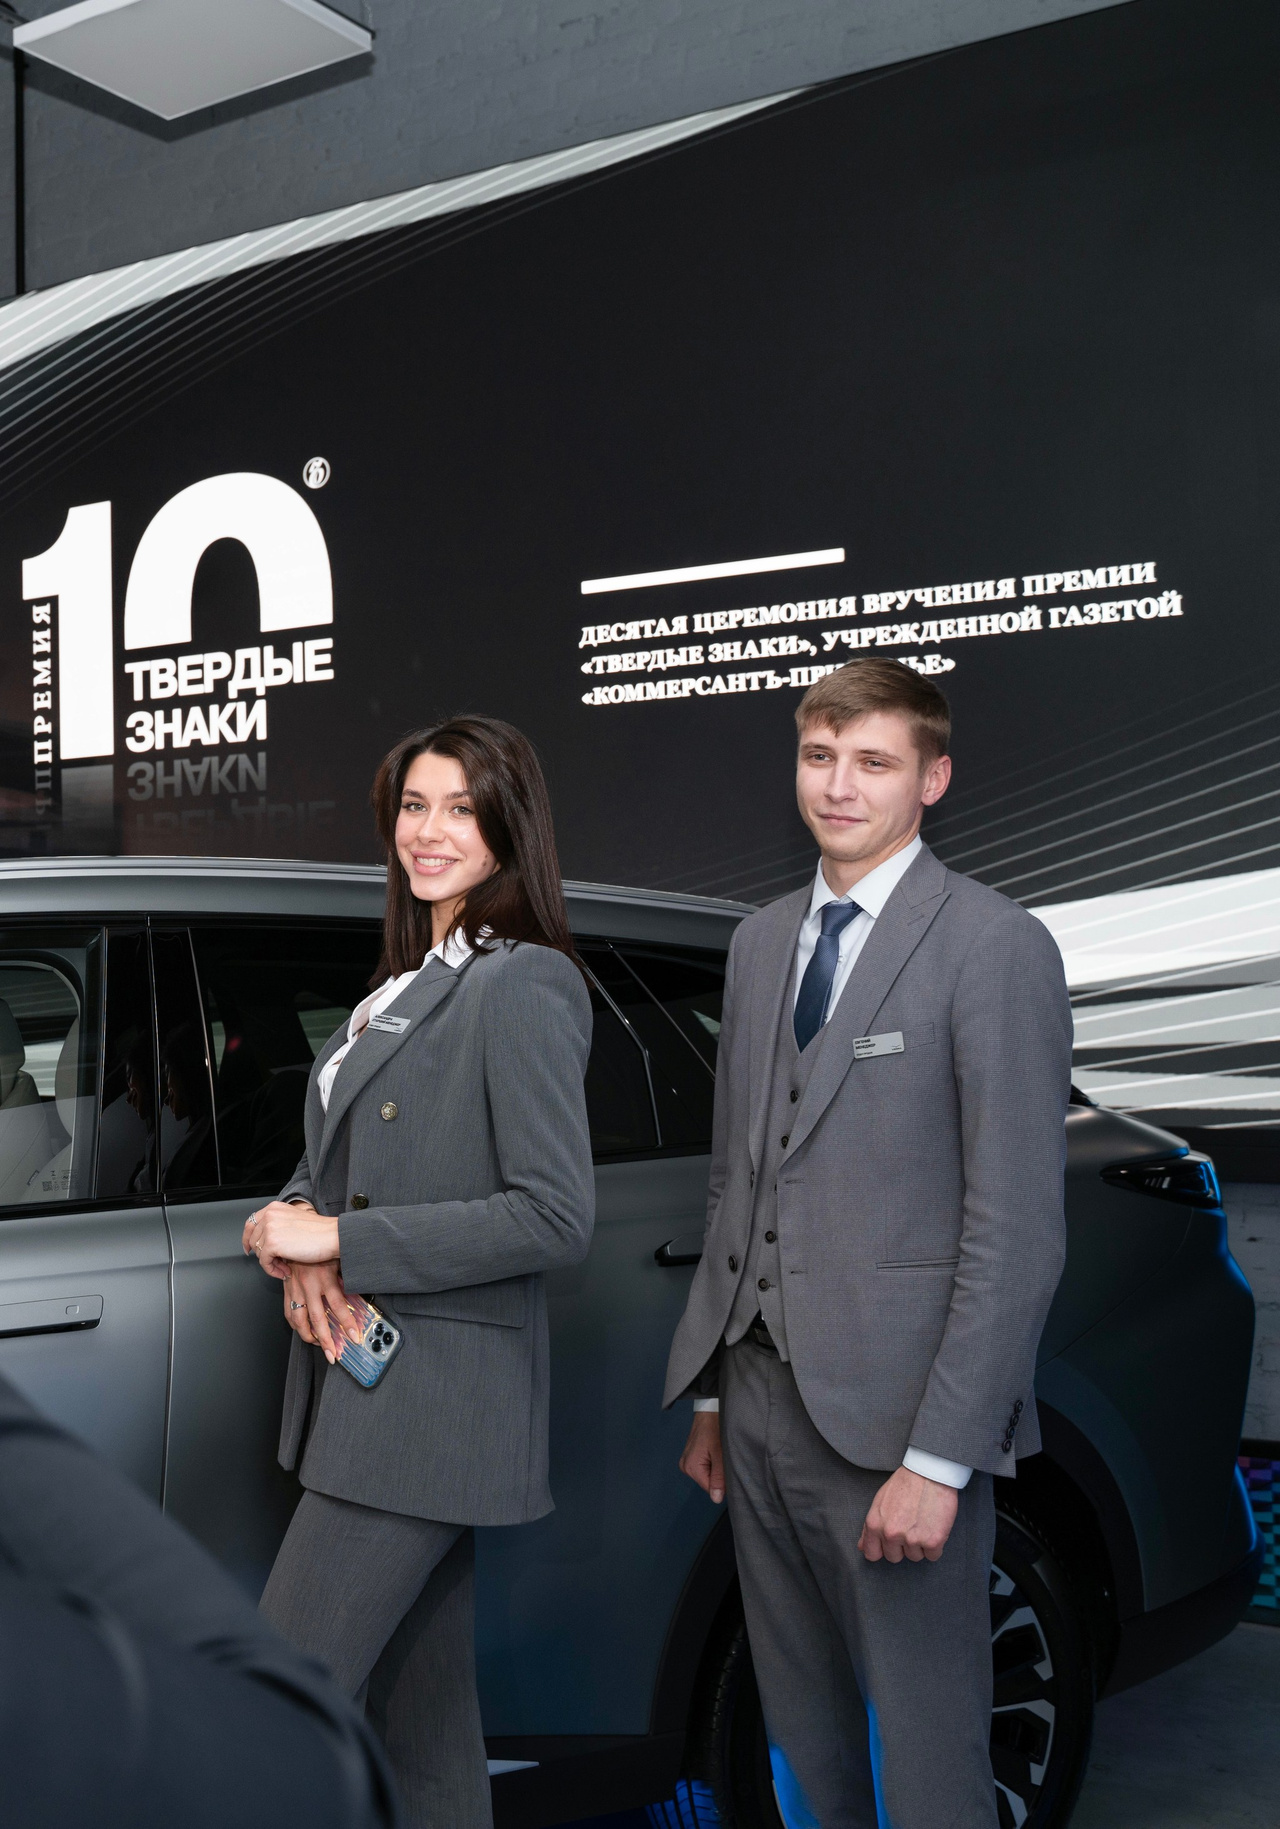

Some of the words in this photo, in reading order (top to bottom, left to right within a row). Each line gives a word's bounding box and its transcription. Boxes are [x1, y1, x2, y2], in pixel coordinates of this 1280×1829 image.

[578, 615, 689, 649] ДЕСЯТАЯ
[693, 596, 857, 634] ЦЕРЕМОНИЯ
[862, 577, 1017, 615] ВРУЧЕНИЯ
[1021, 561, 1157, 597] ПРЕМИИ
[580, 645, 705, 674] «ТВЕРДЫЕ
[707, 635, 818, 663] ЗНАКИ»,
[821, 605, 1043, 651] УЧРЕЖДЕННОЙ
[1048, 589, 1184, 629] ГАЗЕТОЙ
[32, 602, 52, 765] ПРЕМИЯ
[124, 637, 335, 701] ТВЕРДЫЕ
[125, 699, 267, 753] ЗНАКИ
